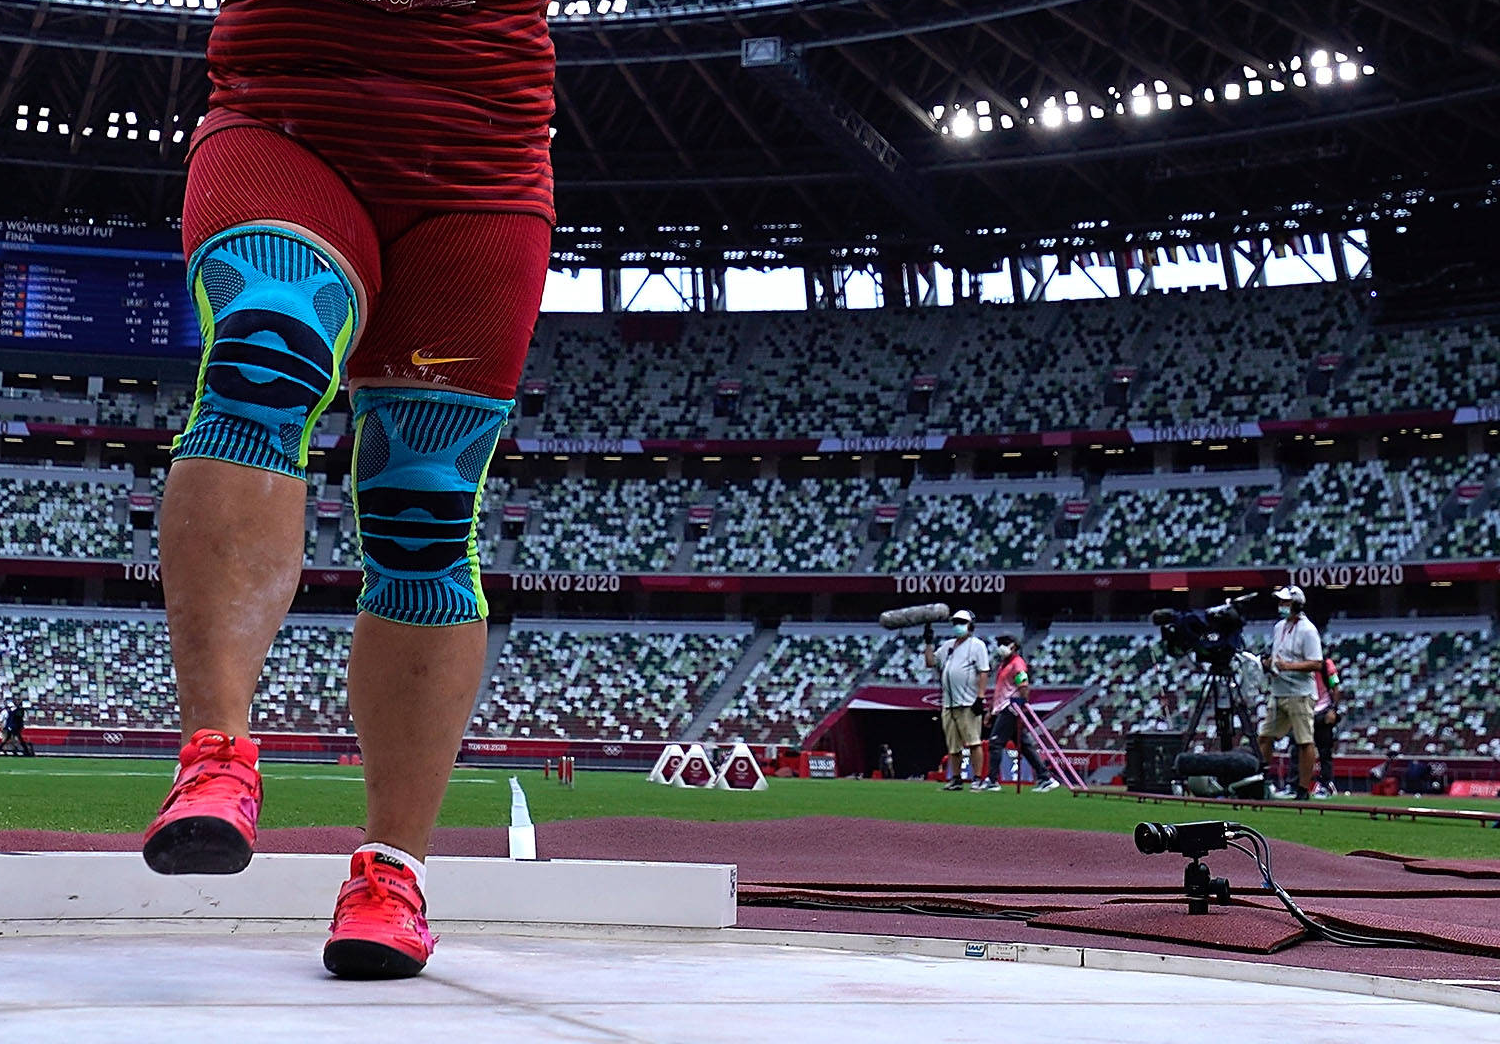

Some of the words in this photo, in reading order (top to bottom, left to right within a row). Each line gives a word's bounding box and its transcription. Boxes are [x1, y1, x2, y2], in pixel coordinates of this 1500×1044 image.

[5, 231, 35, 243] FINAL
[6, 221, 59, 232] WOMEN'S
[61, 224, 90, 236] SHOT
[93, 227, 114, 238] PUT
[1202, 421, 1242, 439] 2020
[510, 573, 571, 592] TOKYO
[574, 573, 620, 592] 2020
[893, 573, 956, 593] TOKYO
[959, 573, 1006, 593] 2020
[1286, 564, 1351, 588] TOKYO
[1355, 564, 1404, 586] 2020
